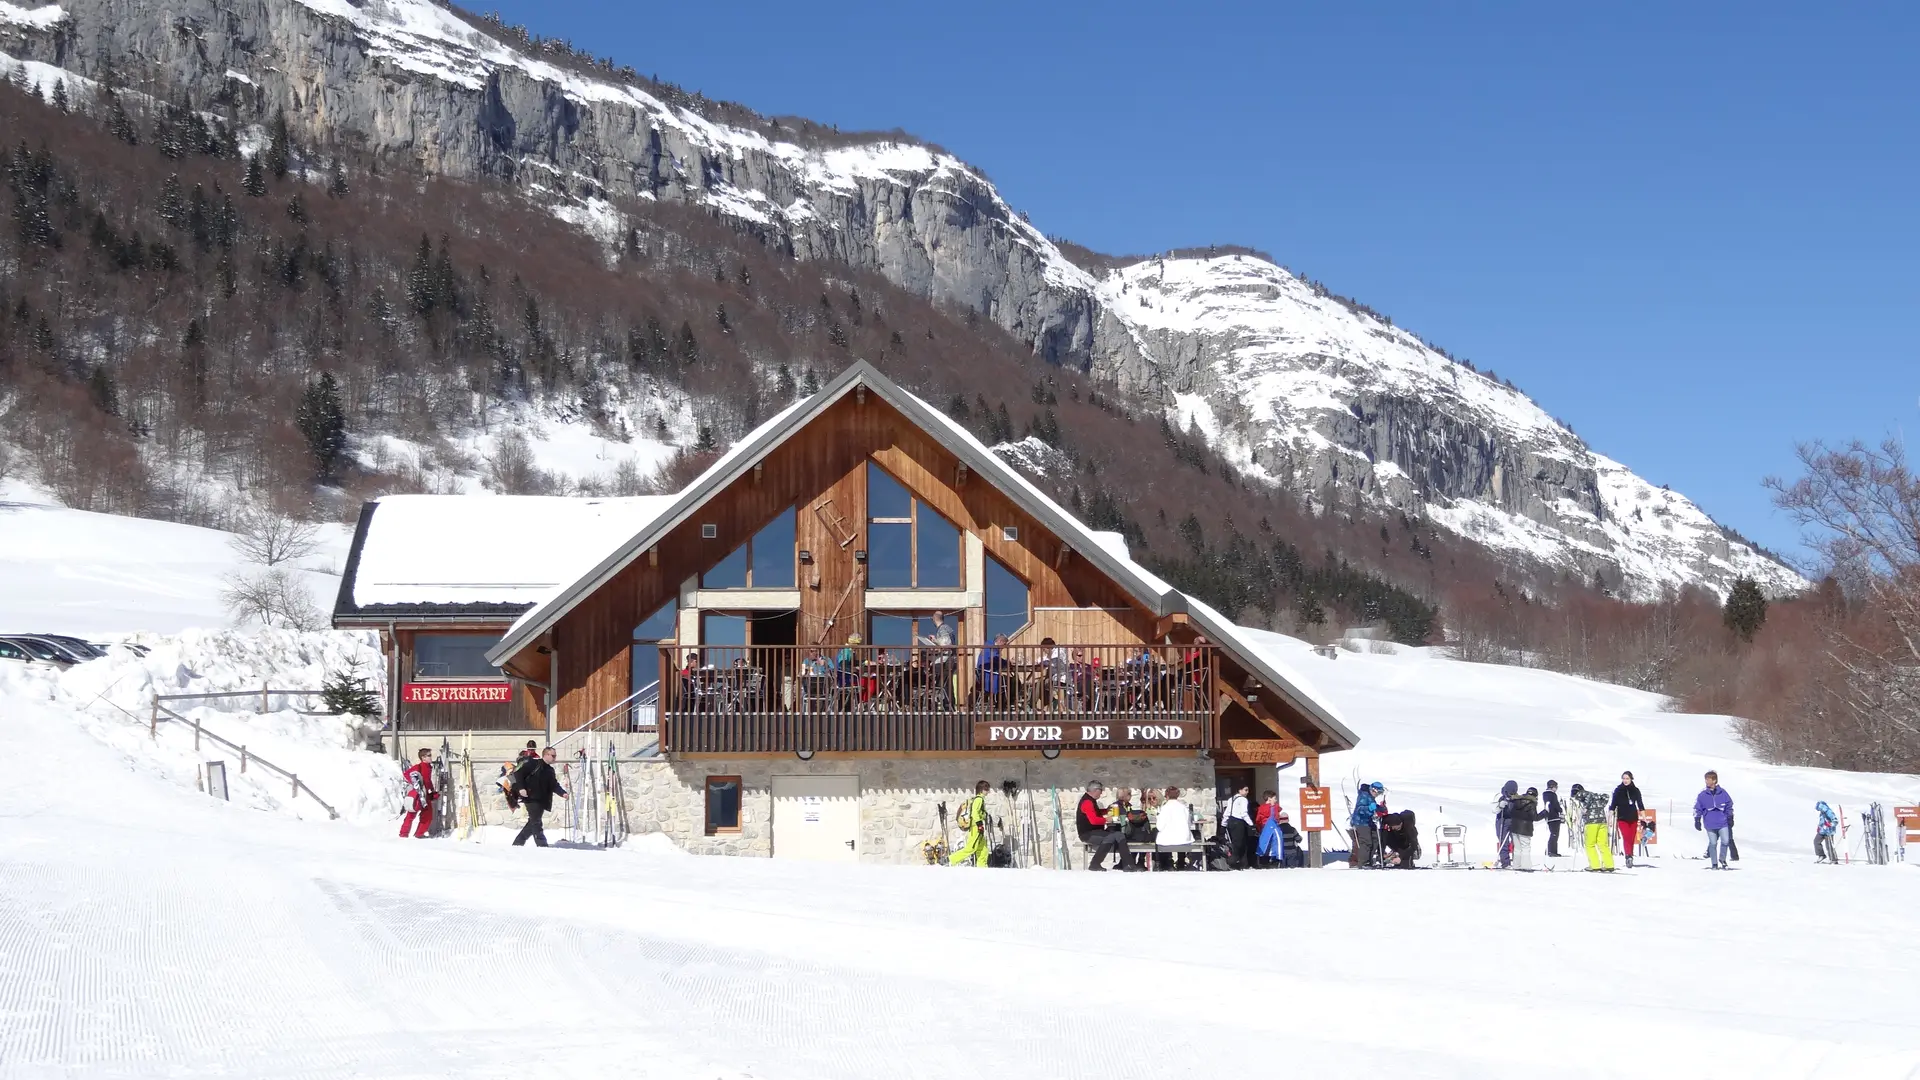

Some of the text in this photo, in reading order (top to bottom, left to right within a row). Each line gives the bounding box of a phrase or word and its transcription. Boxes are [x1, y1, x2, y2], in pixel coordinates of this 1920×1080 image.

[412, 687, 508, 700] RESTAURANT
[989, 725, 1183, 741] FOYER DE FOND
